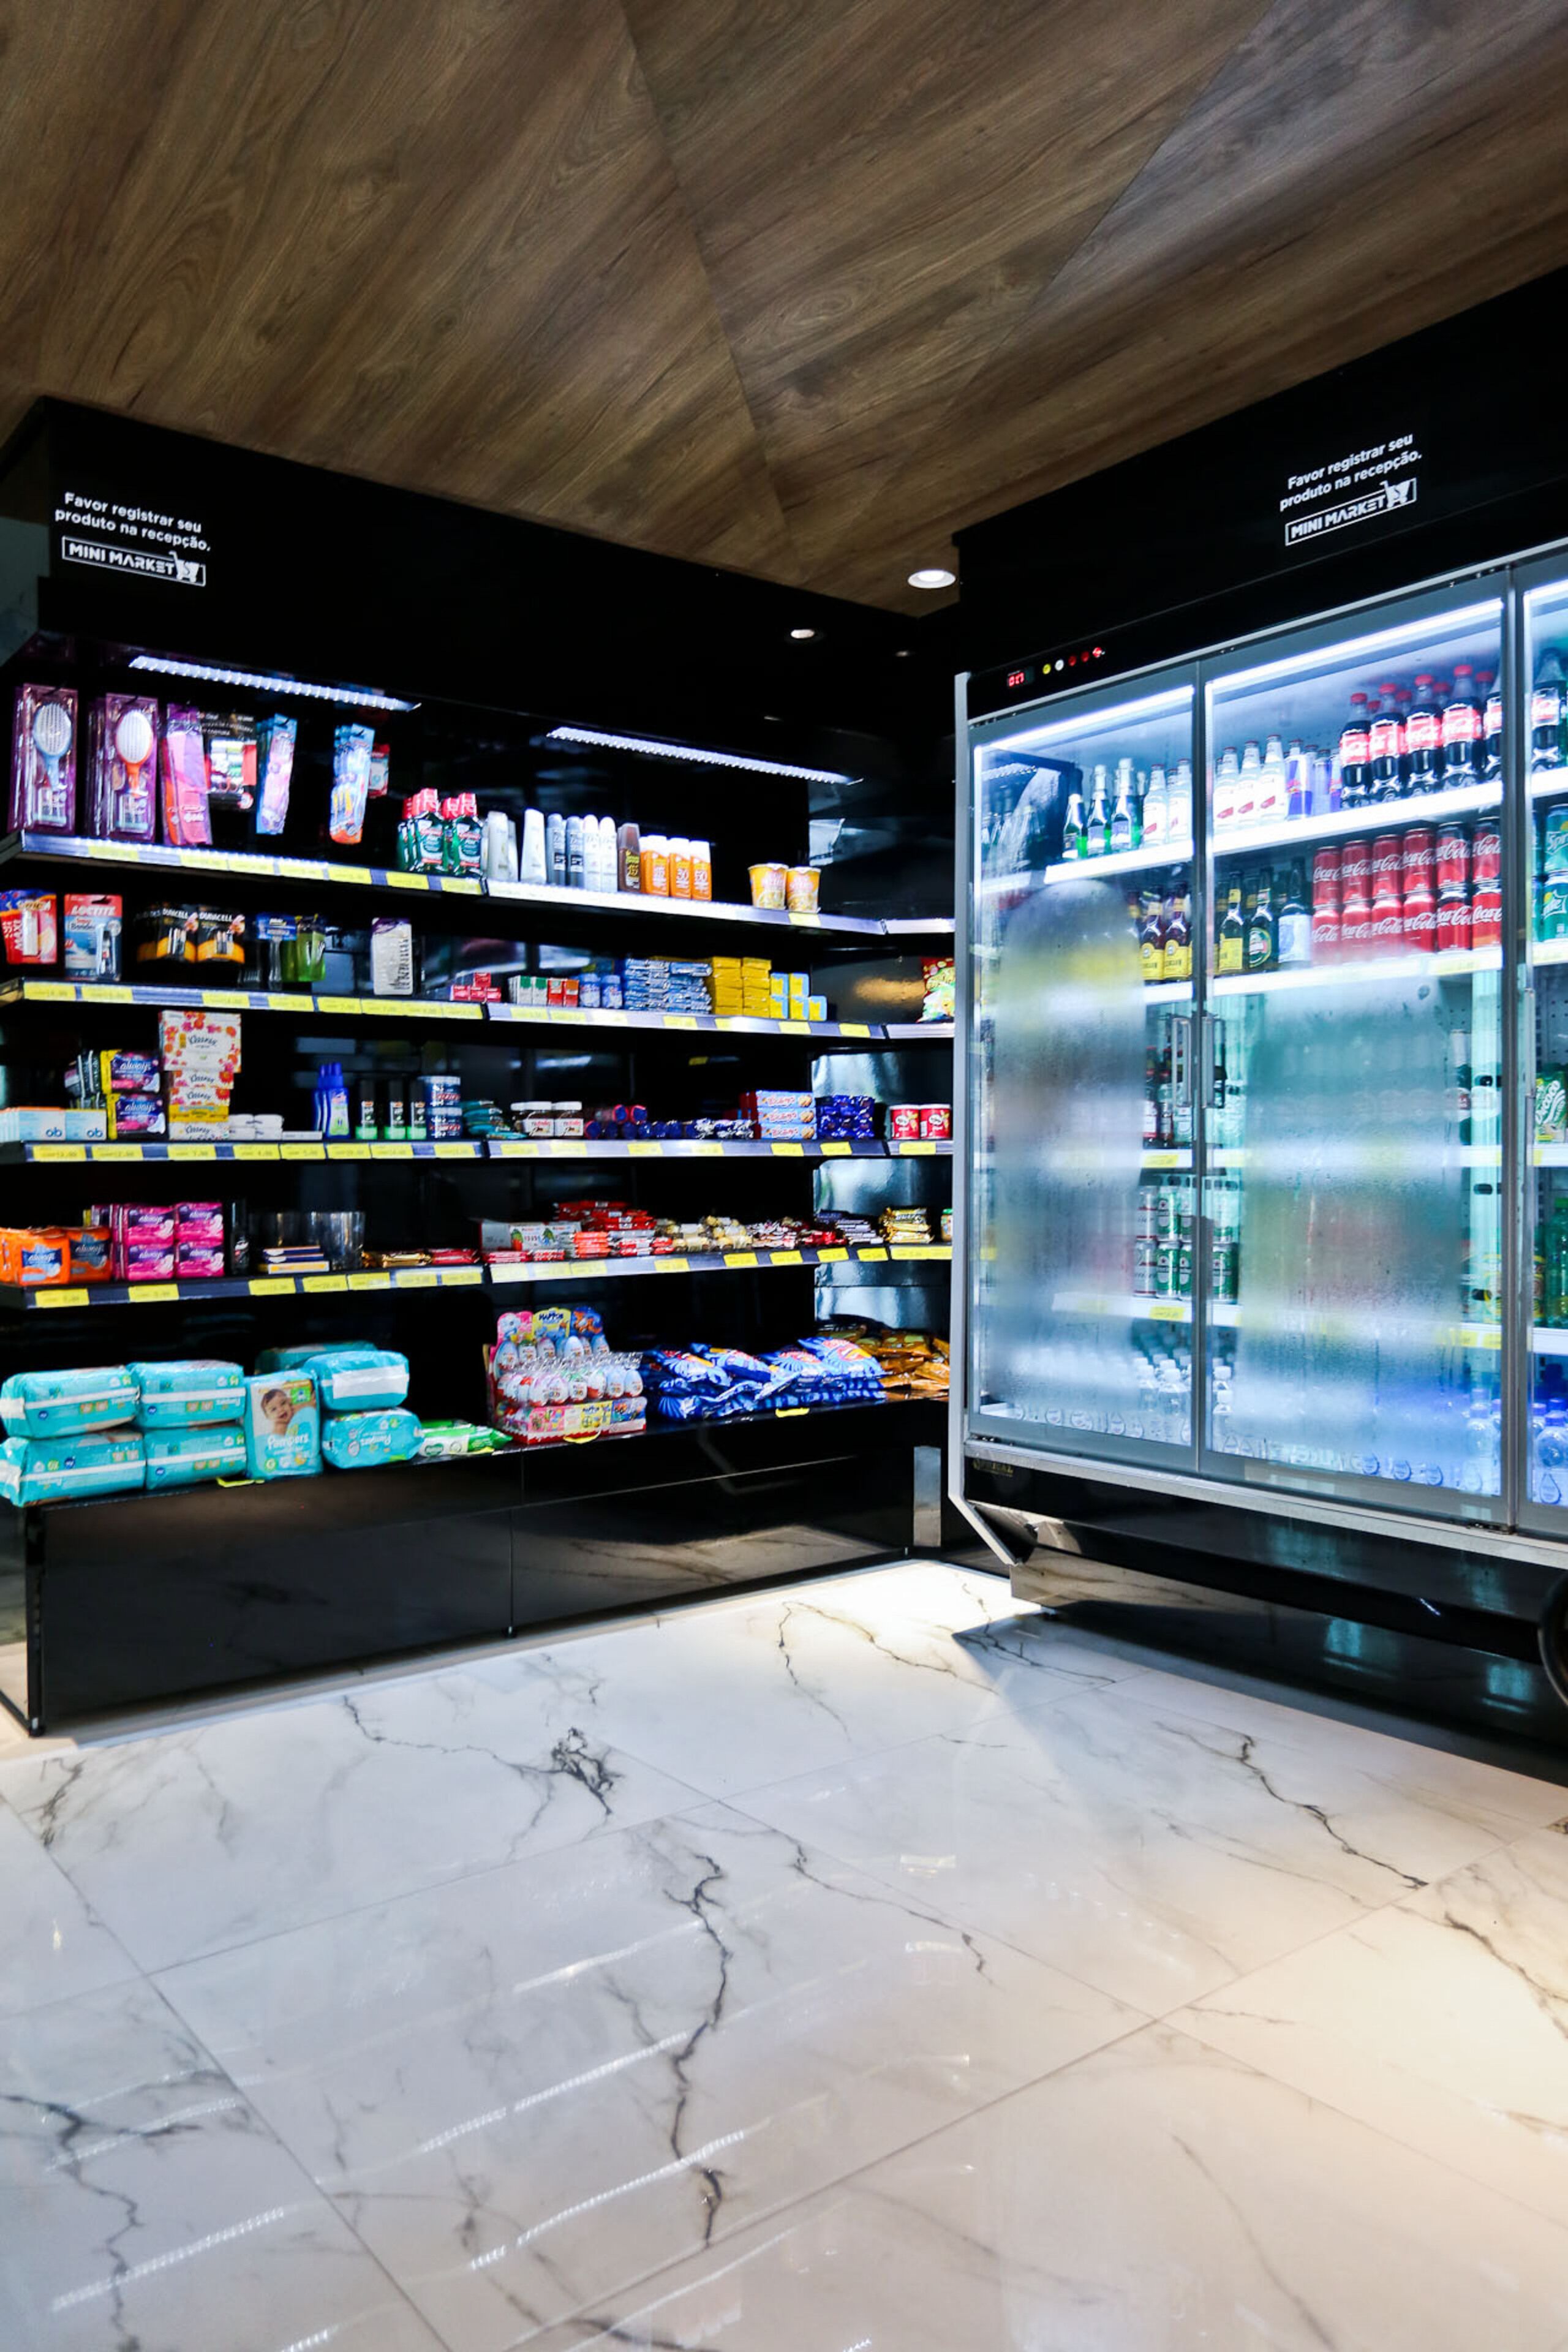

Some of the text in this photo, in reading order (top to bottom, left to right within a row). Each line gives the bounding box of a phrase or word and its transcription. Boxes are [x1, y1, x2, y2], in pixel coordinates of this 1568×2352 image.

[1288, 434, 1413, 489] Favor registrar seu
[1280, 450, 1422, 512] produto na recepção.
[55, 509, 116, 531] produto
[120, 523, 137, 536] na
[64, 492, 202, 533] Favor registrar seu
[1291, 494, 1385, 539] MINI MARKET
[69, 543, 175, 575] MINI MARKET
[71, 905, 116, 916] LOCTITE
[162, 908, 188, 919] DURACELL
[199, 912, 233, 922] DURACELL
[119, 1060, 151, 1071] always
[124, 1103, 156, 1114] always
[267, 1433, 309, 1450] Pampers
